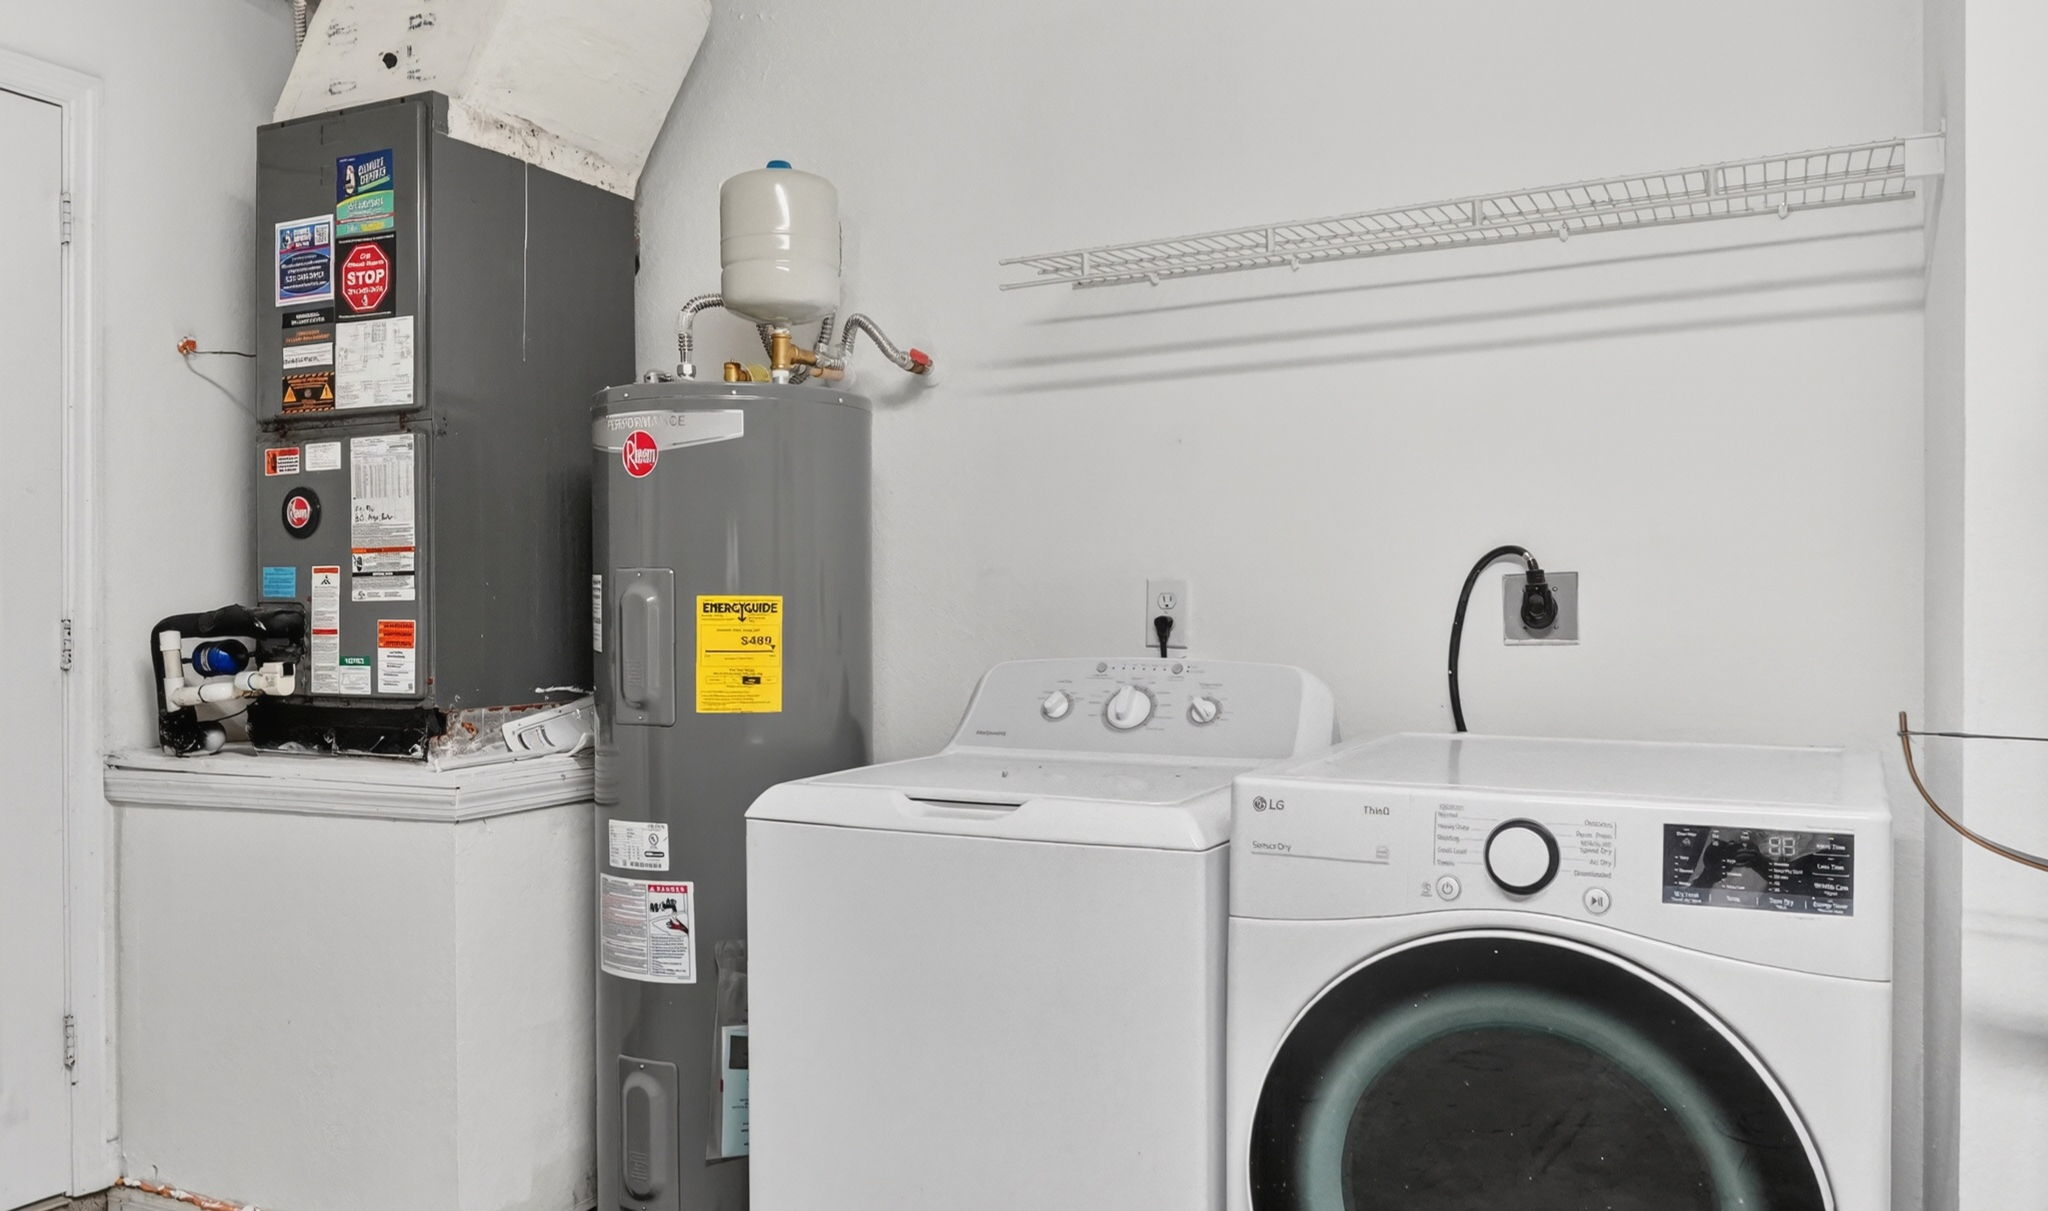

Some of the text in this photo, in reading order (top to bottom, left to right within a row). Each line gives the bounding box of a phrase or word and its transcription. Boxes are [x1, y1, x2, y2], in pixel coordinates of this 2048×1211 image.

[346, 268, 385, 286] STOP
[626, 431, 656, 471] Rheem
[1268, 799, 1285, 811] LG
[1364, 805, 1390, 816] ThinQ
[1252, 840, 1292, 853] Sensor Dry
